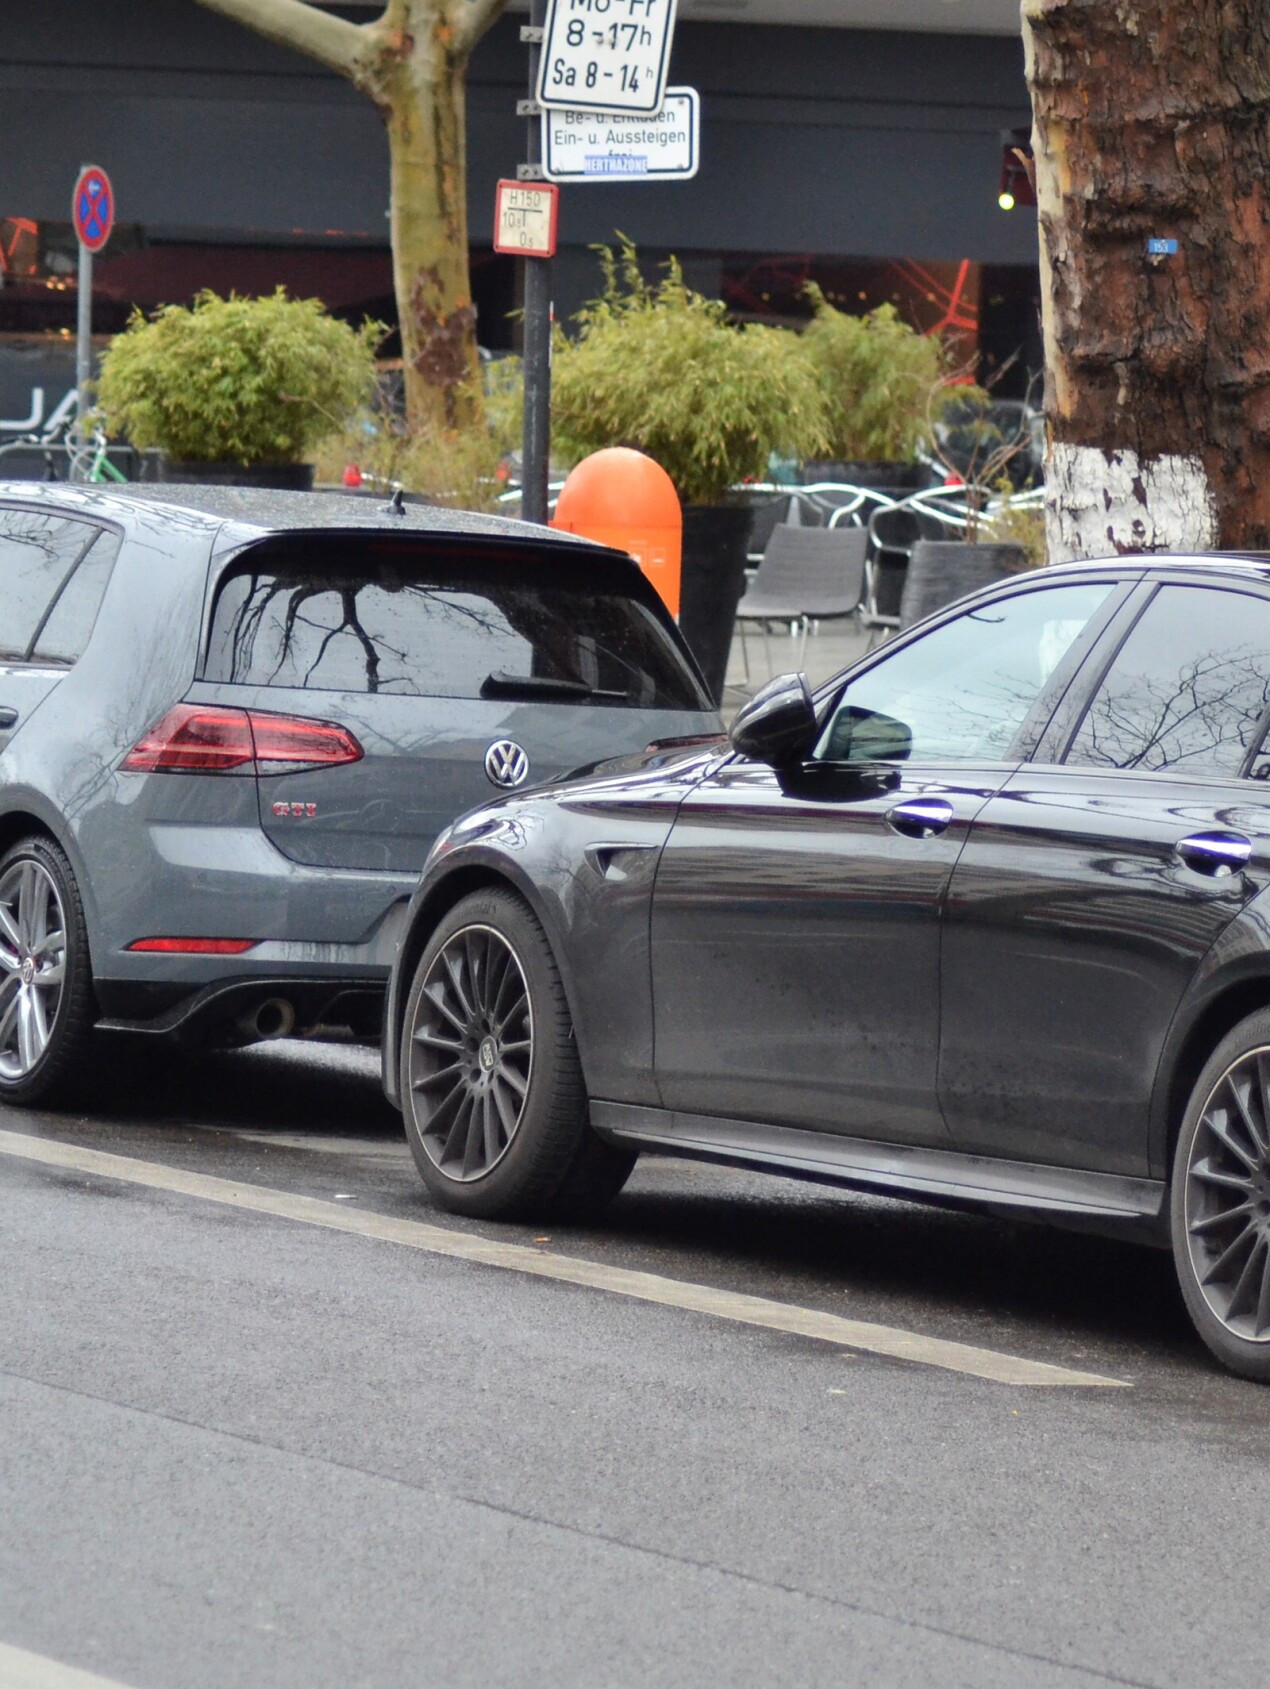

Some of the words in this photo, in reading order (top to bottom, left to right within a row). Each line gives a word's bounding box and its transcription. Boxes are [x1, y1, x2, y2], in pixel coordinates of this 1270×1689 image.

[552, 58, 577, 87] Sa
[564, 109, 591, 124] Be-
[554, 130, 584, 145] Ein-
[588, 133, 601, 144] u.
[605, 128, 686, 147] Aussteigen
[272, 801, 317, 817] GTI
